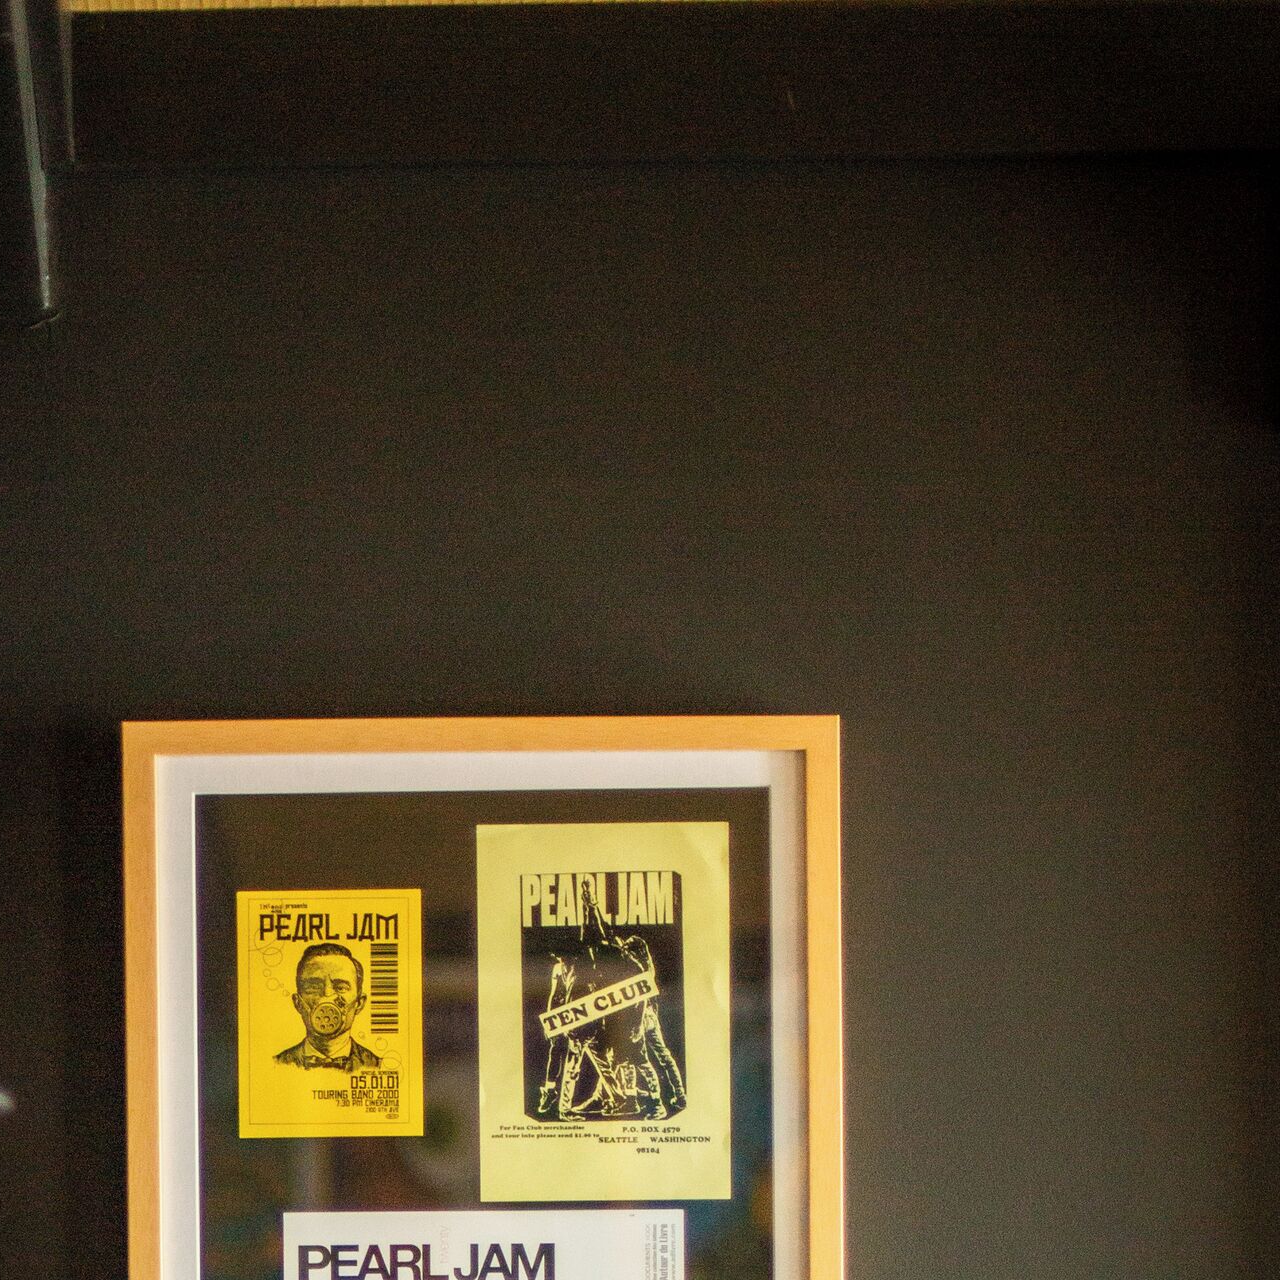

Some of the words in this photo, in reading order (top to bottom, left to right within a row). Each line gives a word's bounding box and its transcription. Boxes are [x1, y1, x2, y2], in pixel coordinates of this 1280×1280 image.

[521, 872, 611, 927] PEARL
[615, 871, 674, 925] JAM
[259, 913, 340, 942] PEARL
[346, 912, 399, 942] JAM
[544, 1004, 589, 1031] TEN
[594, 979, 652, 1012] CLUB
[350, 1075, 399, 1089] 05.01.01
[312, 1090, 349, 1100] TOURING
[351, 1090, 374, 1100] BAND
[377, 1089, 400, 1099] 2000
[364, 1099, 400, 1107] CINERAMA
[662, 1126, 681, 1134] 4570
[598, 1136, 638, 1144] SEATTLE
[659, 1223, 668, 1242] Livre
[659, 1255, 668, 1280] Autour
